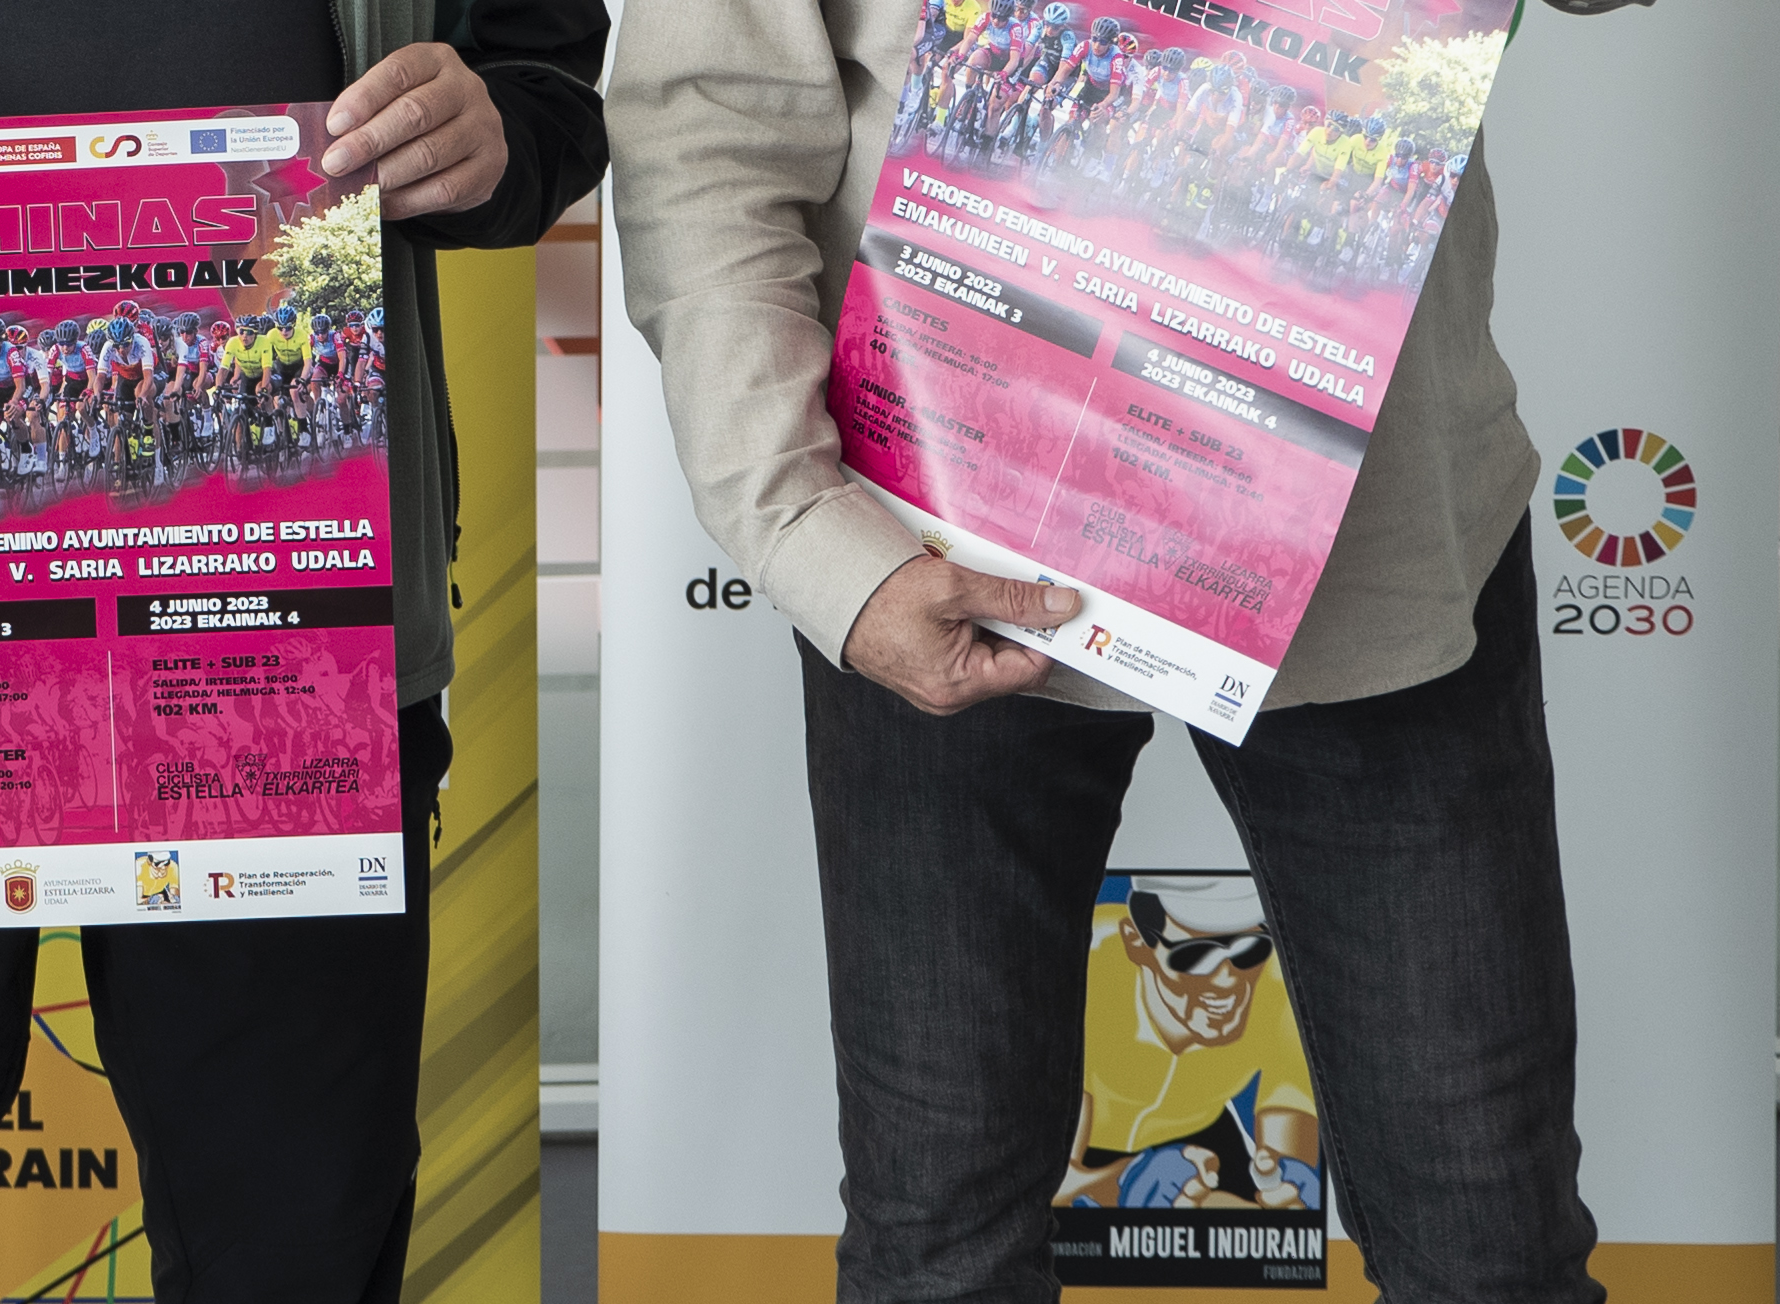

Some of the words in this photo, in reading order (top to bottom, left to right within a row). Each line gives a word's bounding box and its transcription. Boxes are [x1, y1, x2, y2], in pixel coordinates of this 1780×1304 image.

[15, 144, 26, 152] DE
[903, 168, 918, 187] V
[920, 175, 993, 218] TROFEO
[994, 205, 1094, 259] FEMENINO
[1094, 247, 1253, 324] AYUNTAMIENTO
[1255, 312, 1287, 339] DE
[1287, 325, 1374, 376] ESTELLA
[892, 196, 1029, 265] EMAKUMEEN
[1041, 255, 1059, 280] V.
[1073, 270, 1137, 312] SARIA
[1150, 302, 1276, 367] LIZARRAKO
[1288, 358, 1363, 406] UDALA
[62, 523, 238, 548] AYUNTAMIENTO
[243, 522, 274, 541] DE
[279, 519, 373, 539] ESTELLA
[9, 562, 33, 580] V.
[49, 558, 123, 579] SARIA
[138, 552, 275, 575] LIZARRAKO
[291, 549, 374, 569] UDALA
[685, 567, 753, 611] de
[1553, 574, 1695, 600] AGENDA
[149, 600, 162, 613] 4
[166, 597, 221, 613] JUNIO
[226, 596, 268, 610] 2023
[150, 615, 192, 629] 2023
[197, 611, 282, 628] EKAINAK
[287, 611, 300, 624] 4
[1552, 603, 1694, 636] 2030
[1, 622, 11, 636] 3
[151, 656, 201, 671] ELITE
[220, 654, 257, 669] SUB
[260, 653, 281, 667] 23
[152, 703, 183, 717] 102
[187, 701, 223, 716] KM.
[156, 762, 194, 774] CLUB
[302, 757, 359, 769] LIZARRA
[156, 773, 221, 787] CICLISTA
[264, 768, 360, 782] TXIRRINDULARI
[157, 783, 245, 801] ESTELLA
[261, 779, 360, 797] ELKARTEA
[358, 857, 387, 874] DN
[1109, 1225, 1202, 1259] MIGUEL
[1208, 1226, 1323, 1260] INDURAIN
